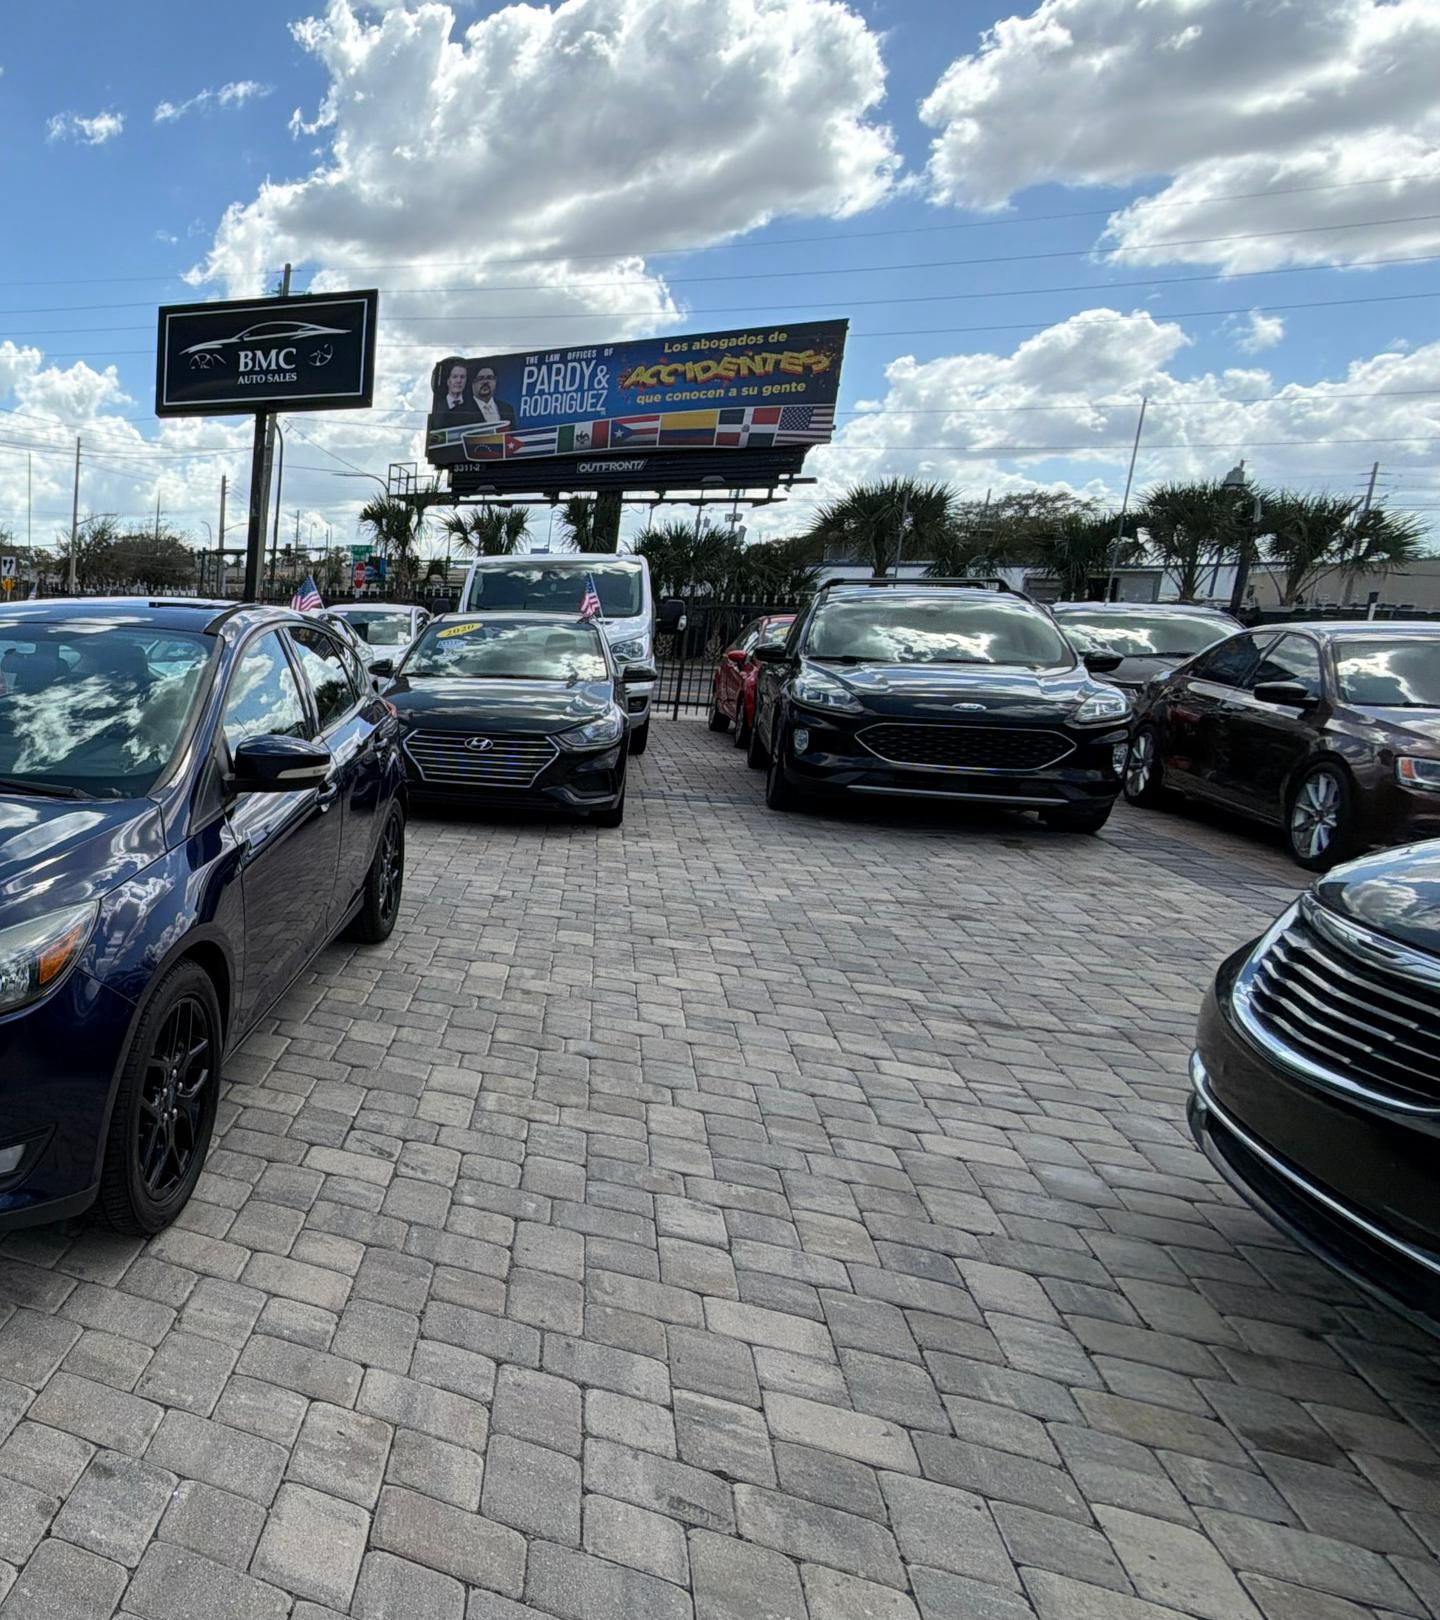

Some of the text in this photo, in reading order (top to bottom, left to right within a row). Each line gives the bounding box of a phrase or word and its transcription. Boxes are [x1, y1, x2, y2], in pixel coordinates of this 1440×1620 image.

[664, 331, 788, 353] Los abogados de
[237, 347, 297, 372] BMC
[525, 347, 614, 365] THE LAW OFFICES OF
[237, 372, 297, 385] AUTO SALES
[623, 350, 831, 387] ACCIDENTES
[520, 389, 608, 417] RODRIGUEZ
[636, 381, 807, 404] que conocen a su gente
